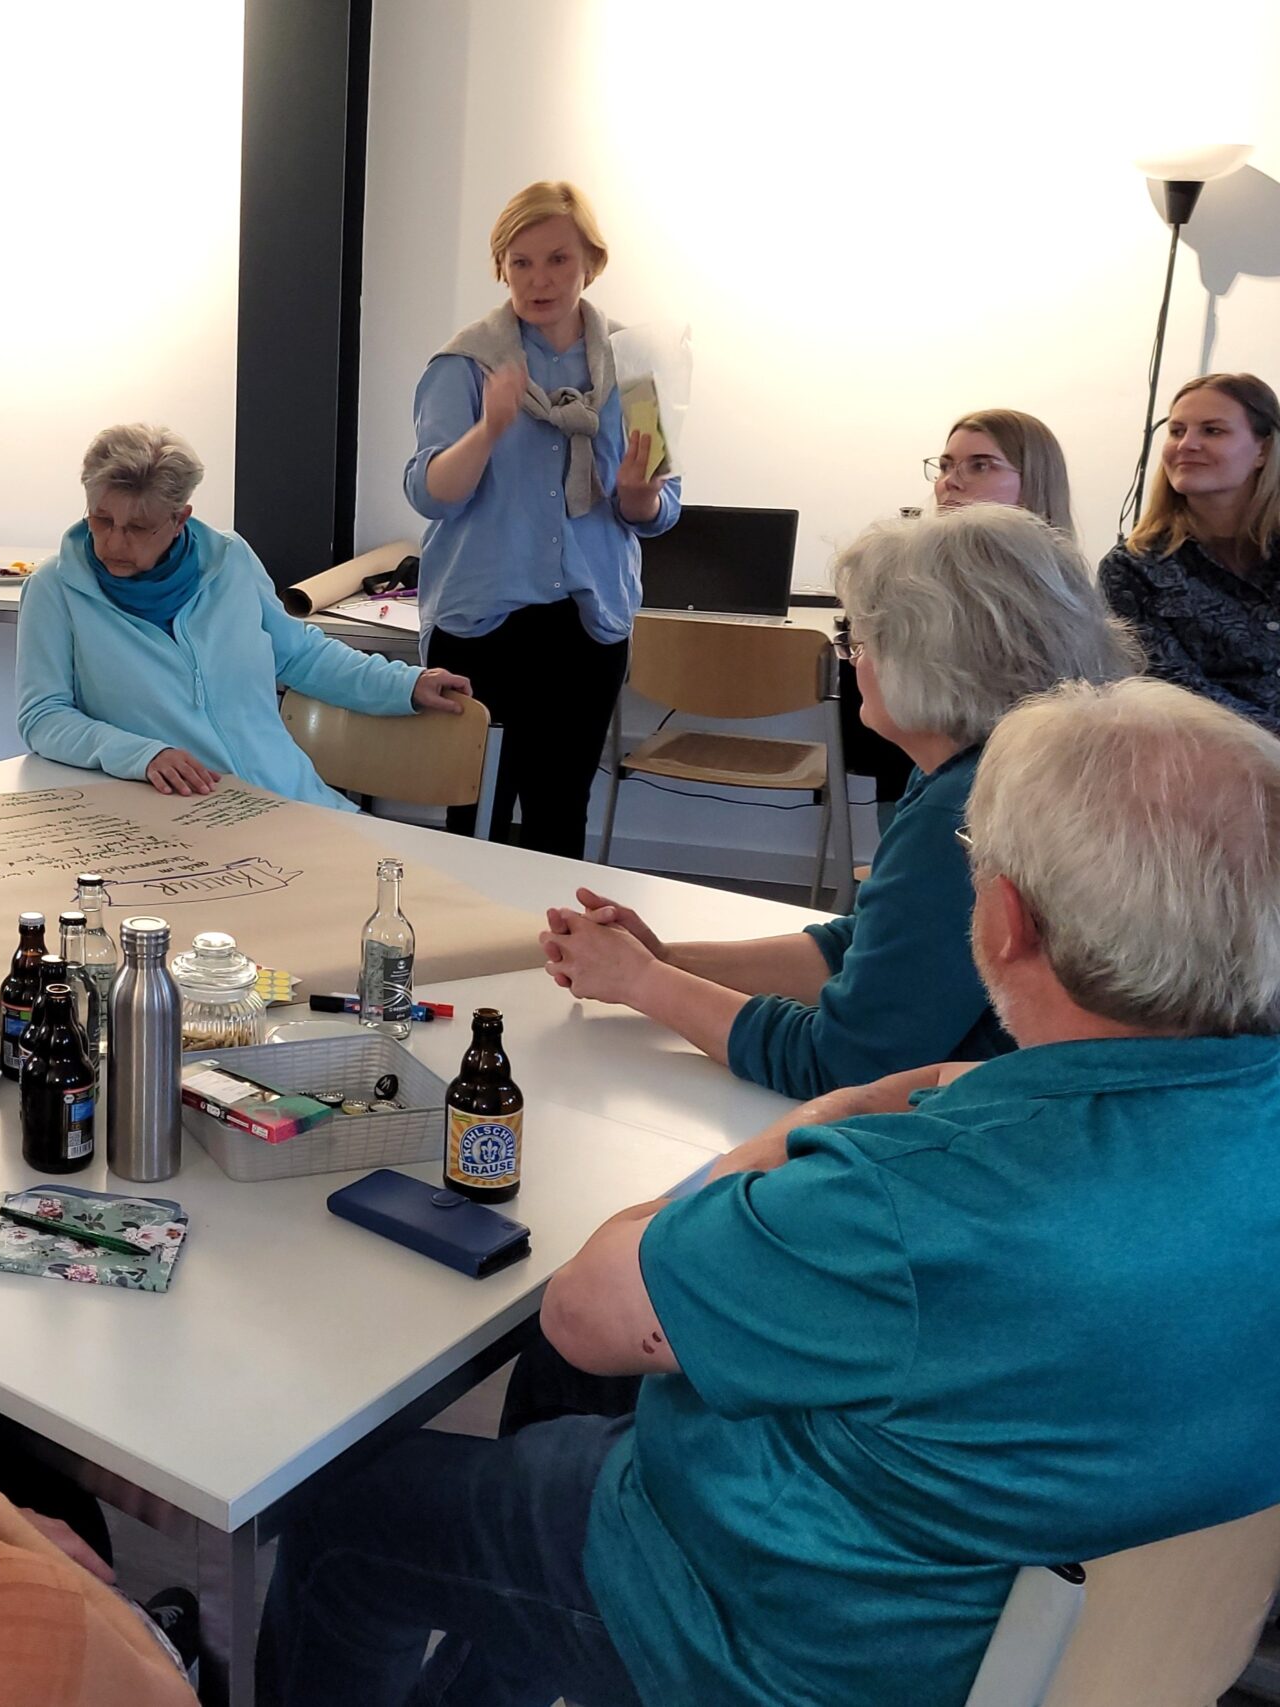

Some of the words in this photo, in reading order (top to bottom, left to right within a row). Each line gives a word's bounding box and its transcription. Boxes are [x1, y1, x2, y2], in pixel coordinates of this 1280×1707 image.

[144, 869, 263, 897] KULTUR
[463, 1126, 515, 1158] KOHLSCHEIN
[462, 1159, 513, 1175] BRAUSE
